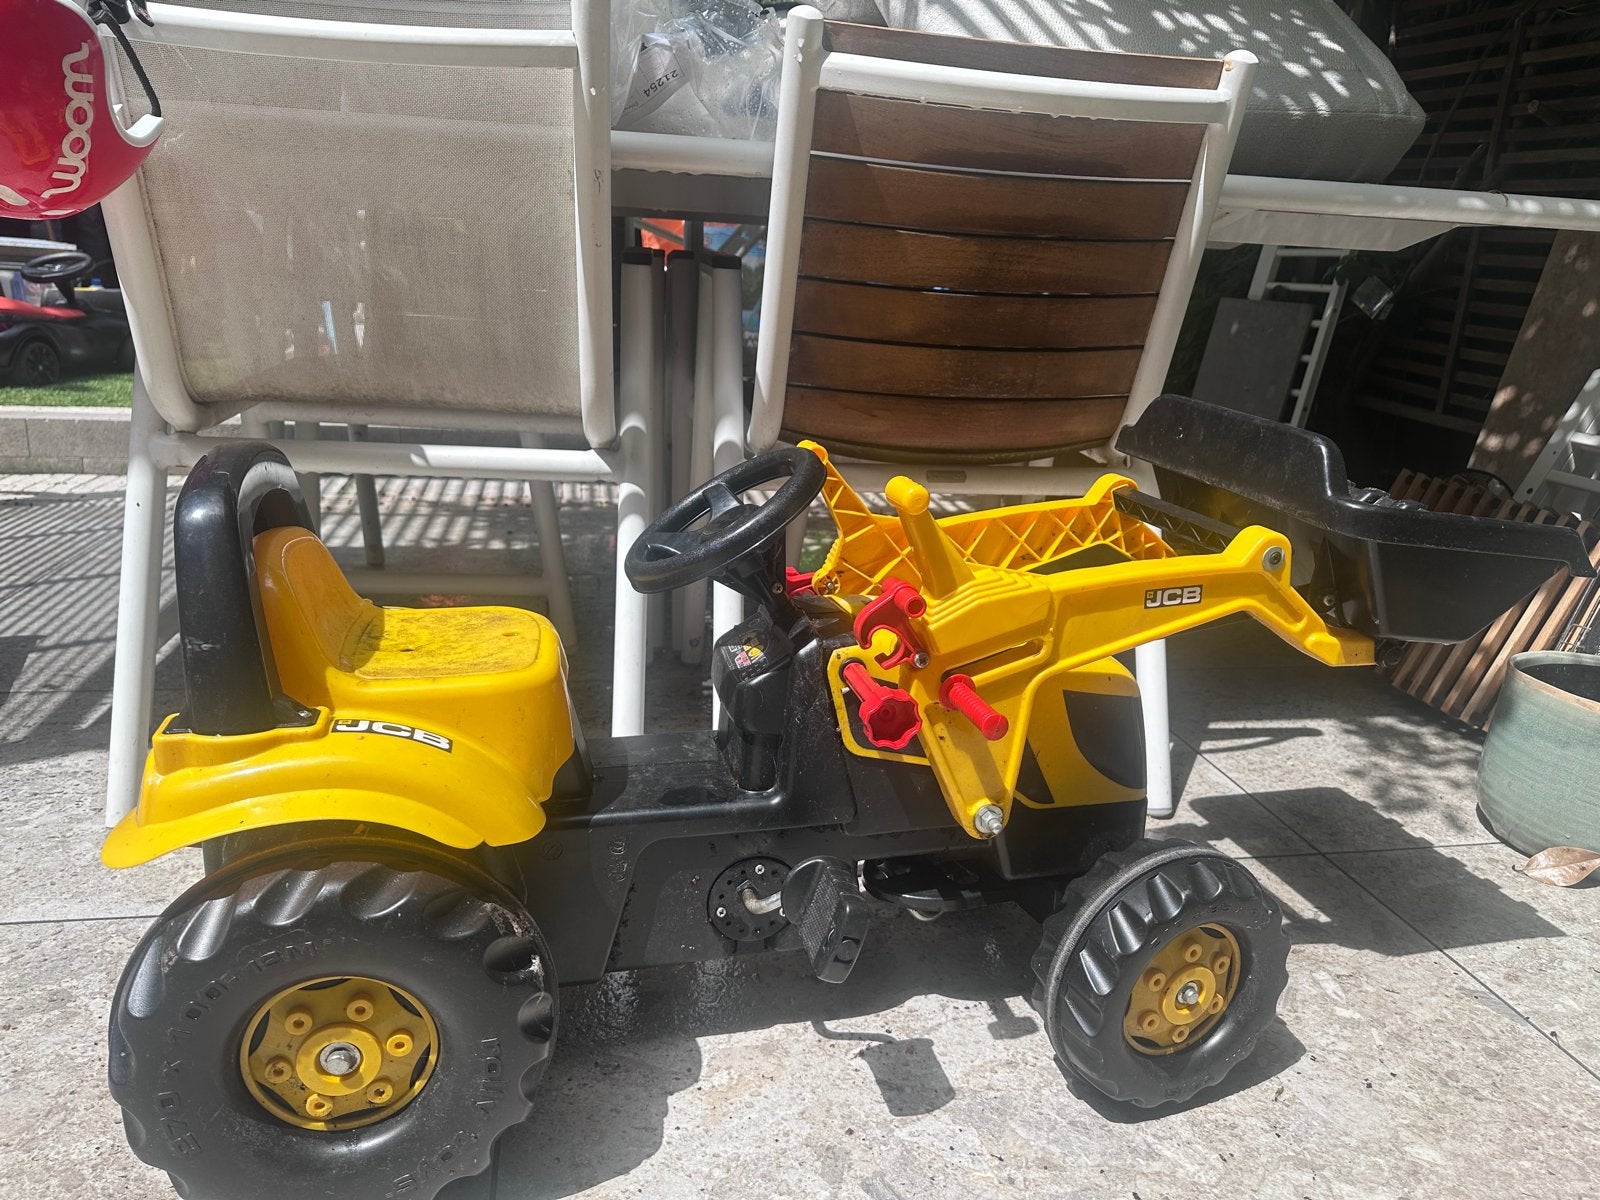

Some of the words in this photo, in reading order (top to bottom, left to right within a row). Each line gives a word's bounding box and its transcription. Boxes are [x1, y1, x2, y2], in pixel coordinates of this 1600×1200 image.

[642, 69, 679, 98] 21254
[40, 41, 94, 199] woom
[1146, 586, 1202, 608] JCB
[334, 718, 451, 751] JCB
